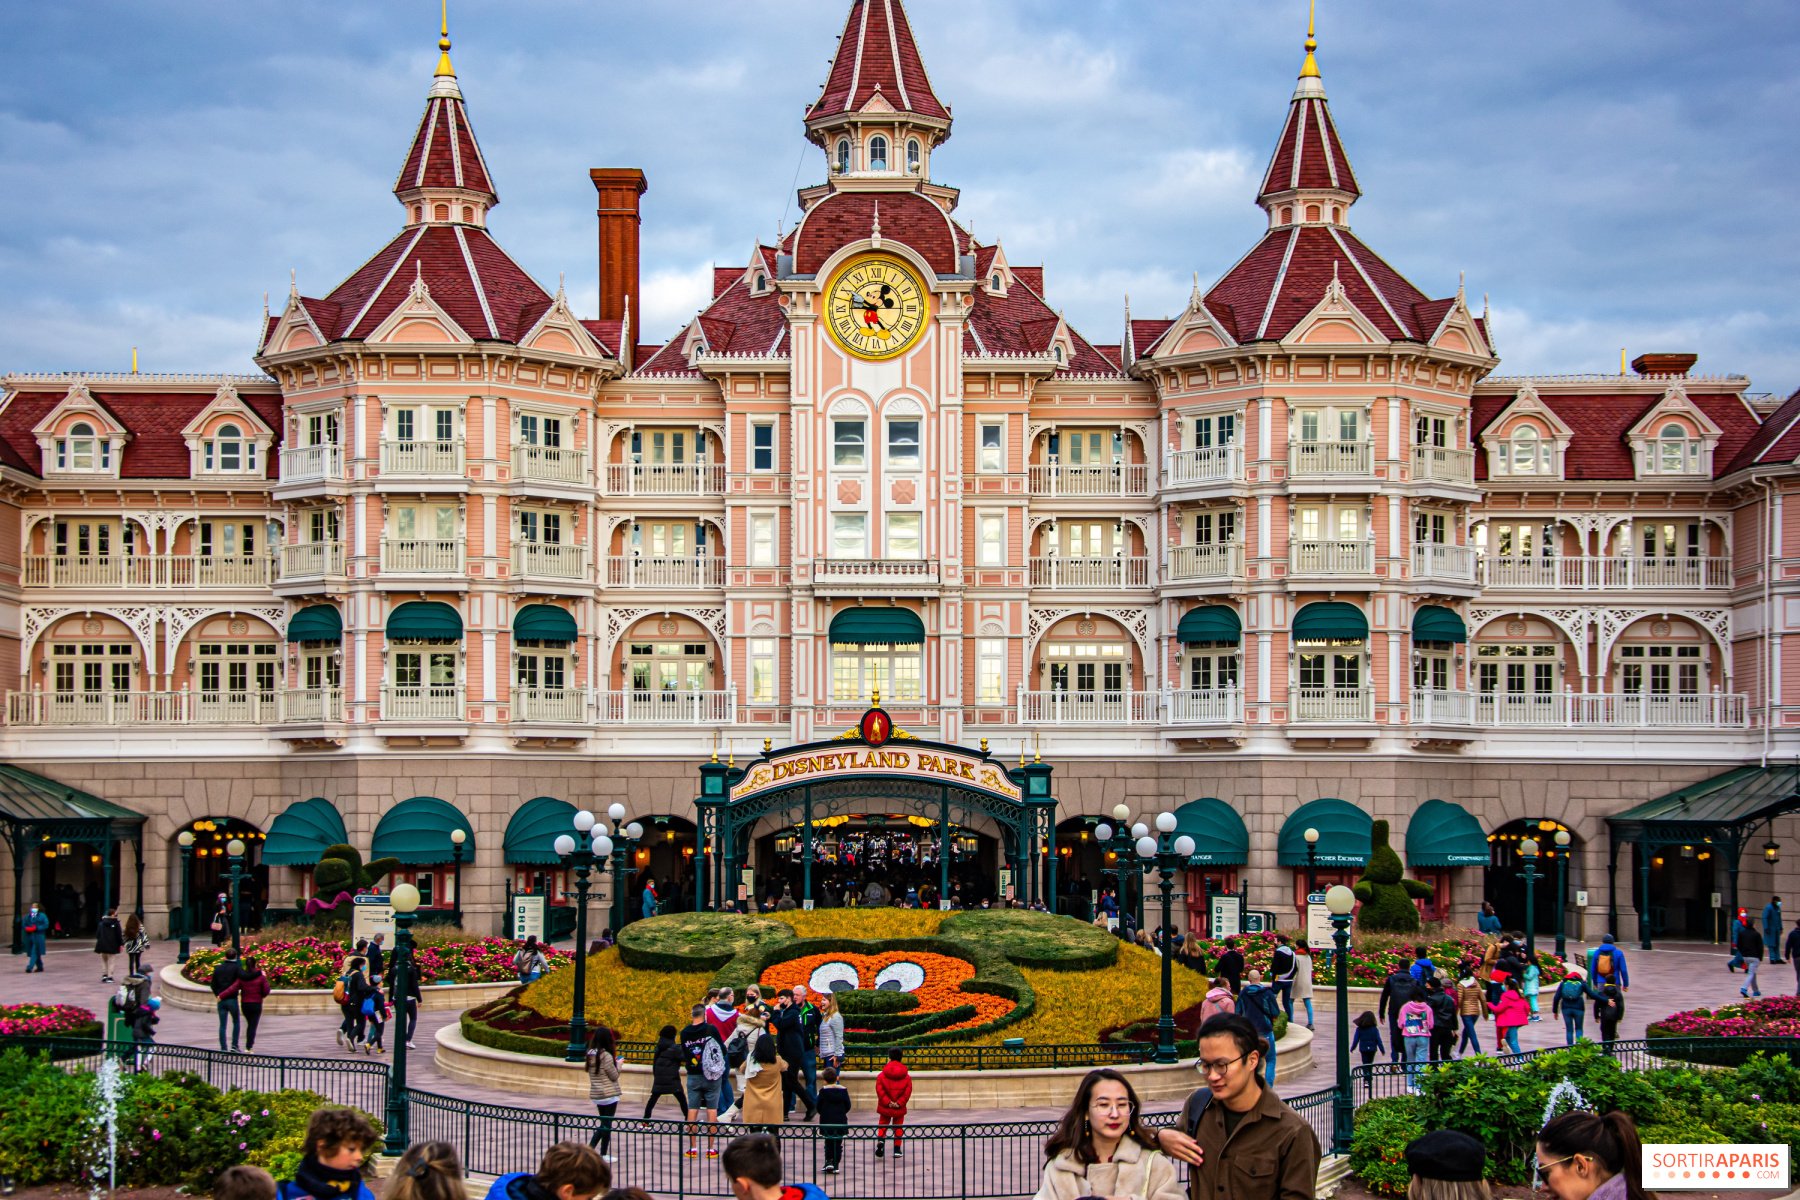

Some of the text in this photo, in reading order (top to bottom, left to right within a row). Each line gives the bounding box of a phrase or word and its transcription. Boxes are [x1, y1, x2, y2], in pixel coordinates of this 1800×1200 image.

[853, 272, 864, 283] XI
[871, 268, 881, 278] XII
[772, 751, 975, 781] DISNEYLAND PARK
